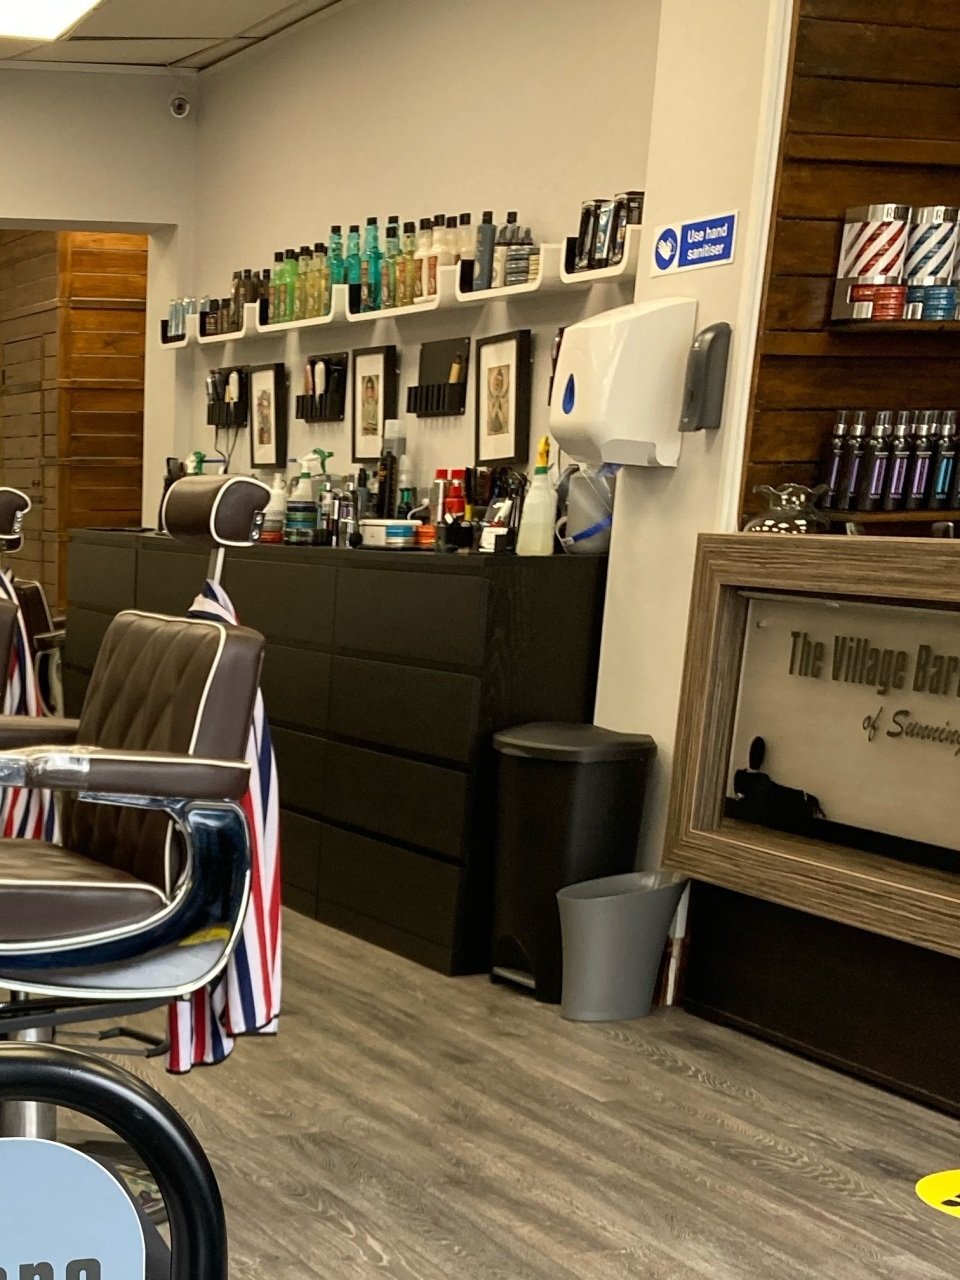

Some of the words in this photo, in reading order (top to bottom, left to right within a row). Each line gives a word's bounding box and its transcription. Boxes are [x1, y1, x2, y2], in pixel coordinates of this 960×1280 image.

[687, 229, 704, 243] Use
[705, 222, 729, 240] hand
[686, 243, 725, 260] sanitiser
[788, 630, 825, 680] The
[831, 635, 909, 696] Village
[912, 644, 960, 698] Bar
[862, 706, 884, 743] of
